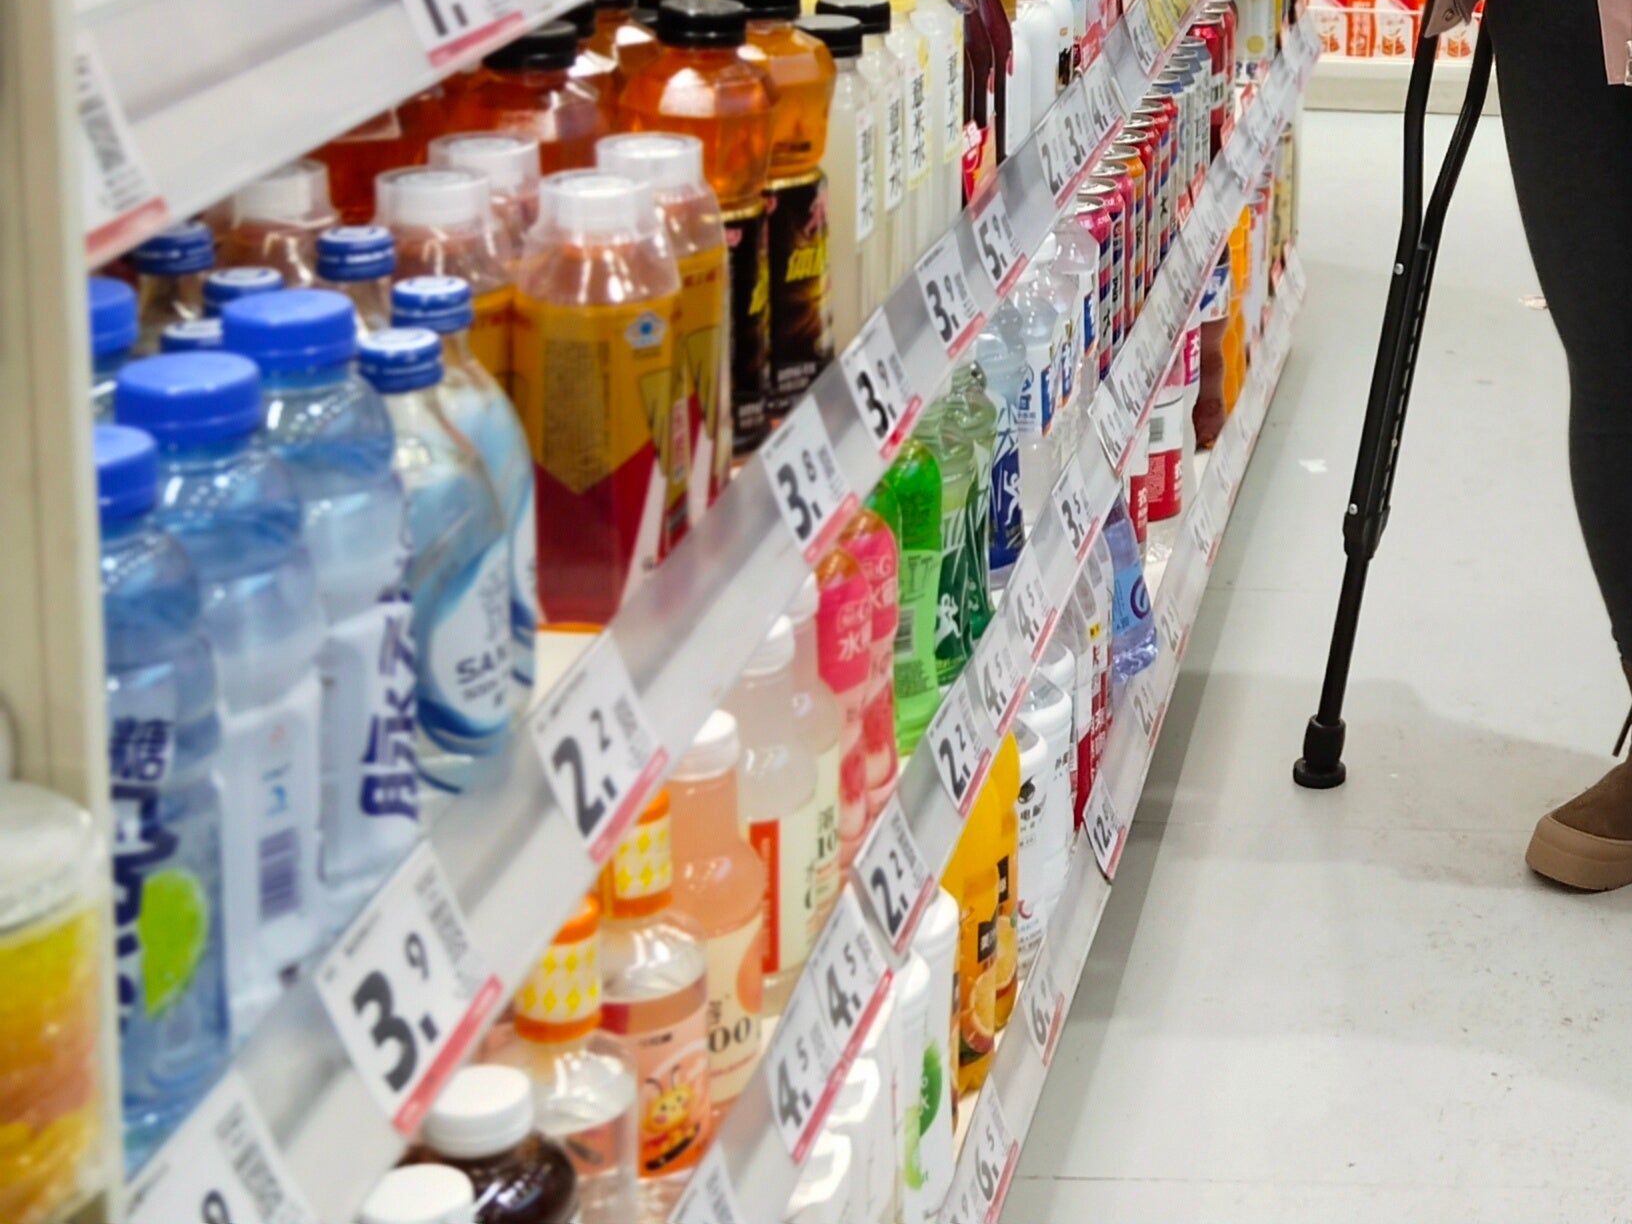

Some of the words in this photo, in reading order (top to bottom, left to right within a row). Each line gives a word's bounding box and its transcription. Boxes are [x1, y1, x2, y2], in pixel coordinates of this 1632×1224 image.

[551, 708, 619, 841] 2.2
[938, 721, 971, 803] 2.2
[869, 848, 911, 940] 2.2
[350, 932, 441, 1094] 3.9
[824, 944, 864, 1032] 4.5
[776, 1041, 813, 1134] 4.5
